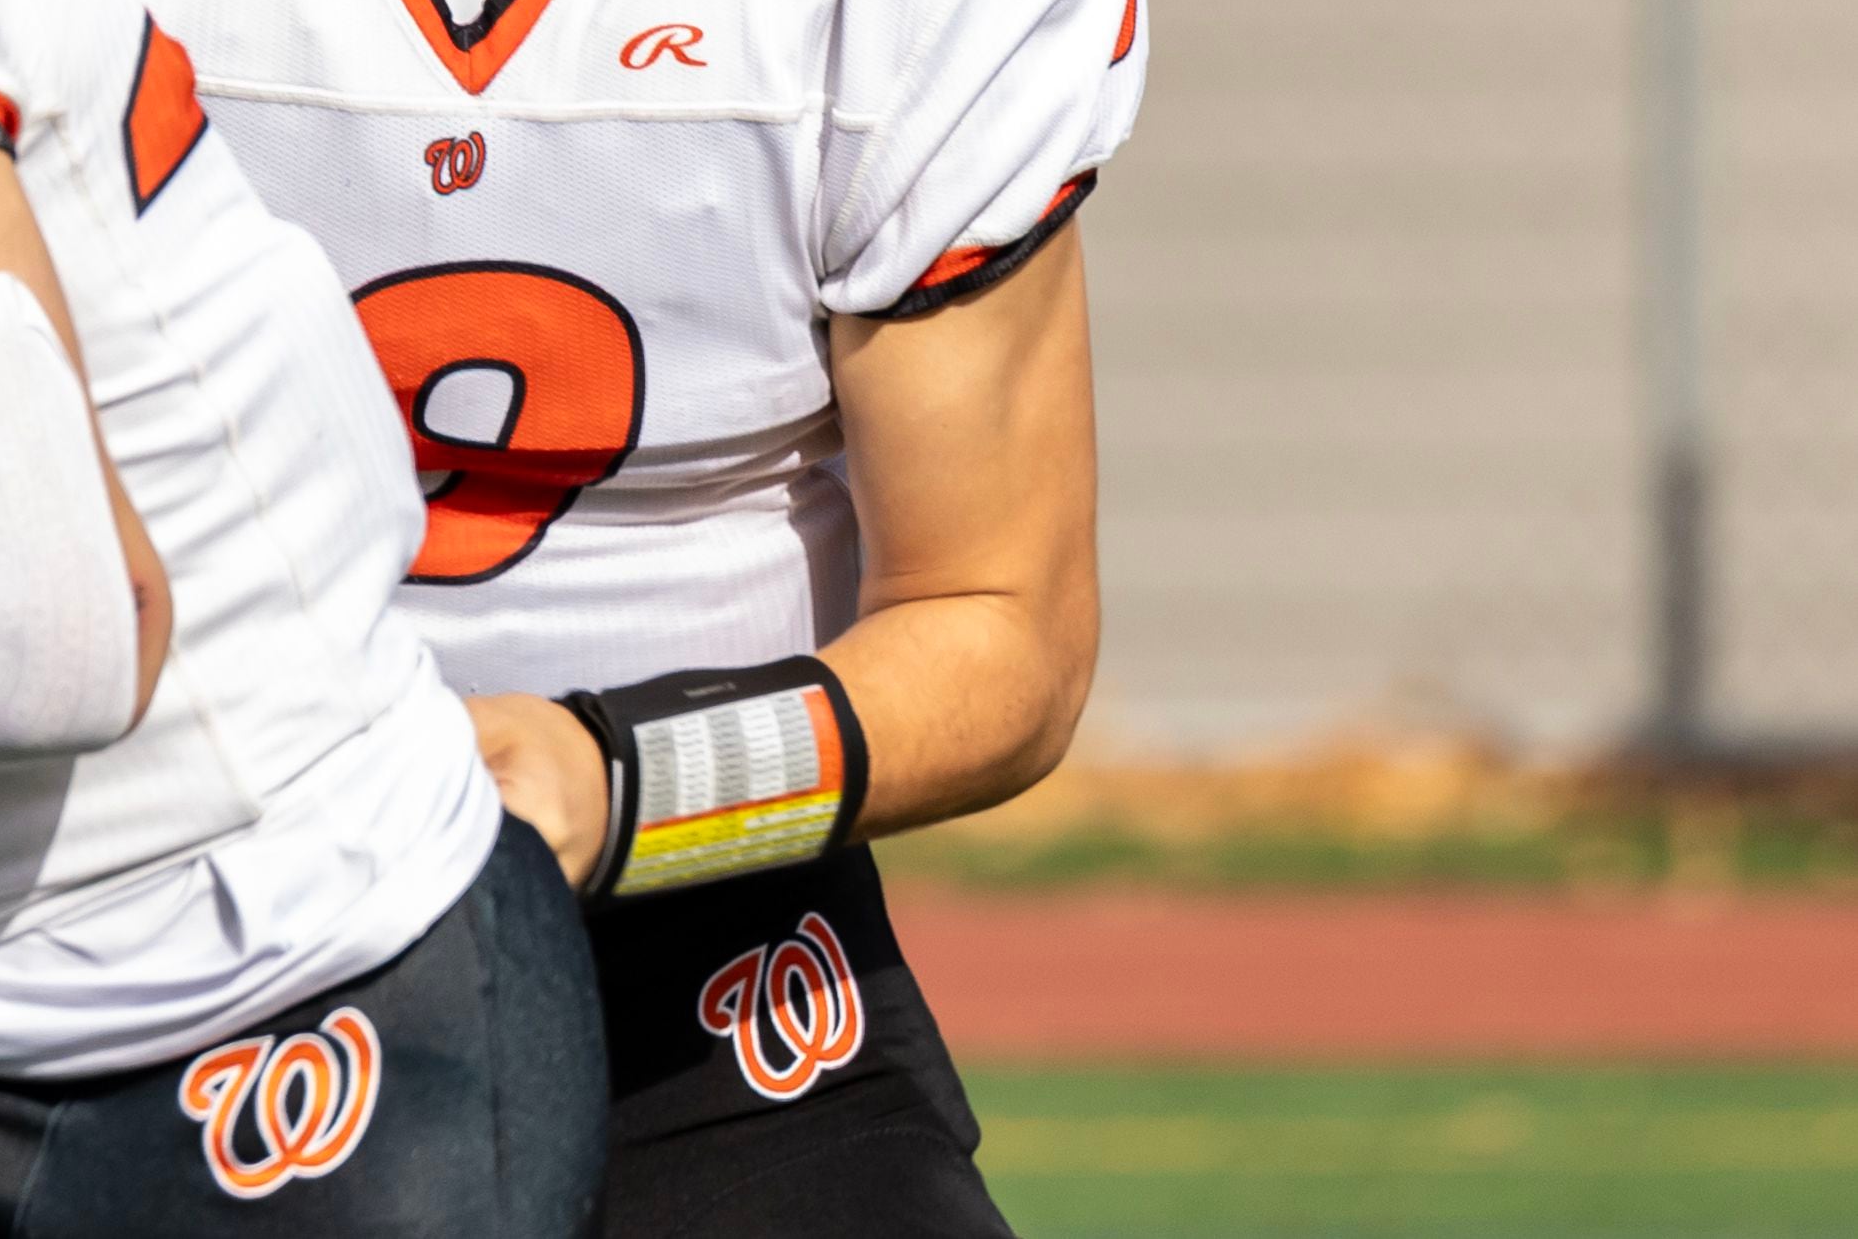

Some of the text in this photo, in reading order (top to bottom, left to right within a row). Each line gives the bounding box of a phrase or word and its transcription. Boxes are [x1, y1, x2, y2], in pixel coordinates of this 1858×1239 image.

[425, 131, 485, 194] W
[348, 260, 645, 585] 9
[179, 1006, 381, 1200] W
[698, 912, 865, 1102] W
